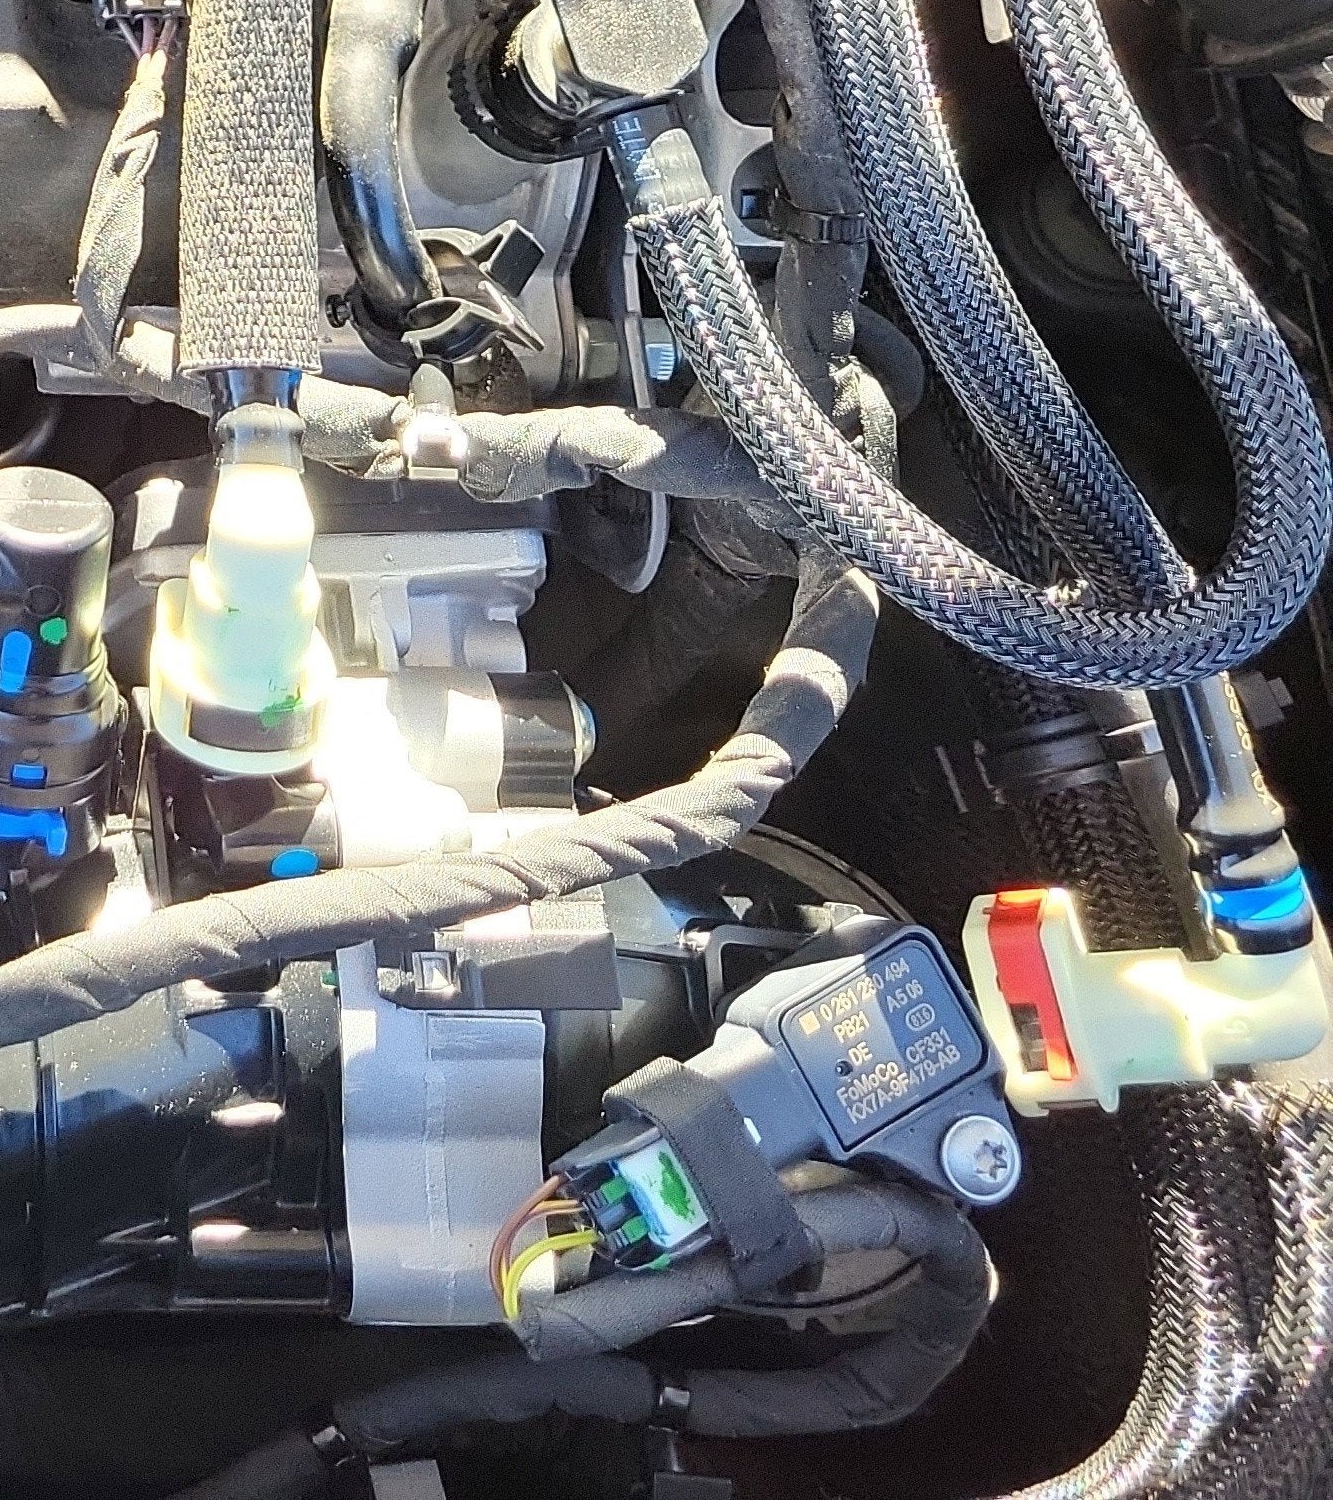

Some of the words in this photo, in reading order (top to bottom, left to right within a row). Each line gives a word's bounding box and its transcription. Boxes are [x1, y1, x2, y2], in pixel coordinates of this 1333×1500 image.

[819, 1003, 833, 1022] 0
[831, 987, 859, 1016] 261
[856, 972, 884, 1000] 230
[885, 957, 911, 982] 494
[886, 987, 909, 1014] A5
[905, 979, 924, 999] 06
[833, 1010, 870, 1044] PB21
[905, 1026, 952, 1064] CF331
[848, 1041, 873, 1067] DE
[835, 1061, 899, 1108] FoMoCo
[846, 1044, 961, 1125] KX7A-9F479-AB
